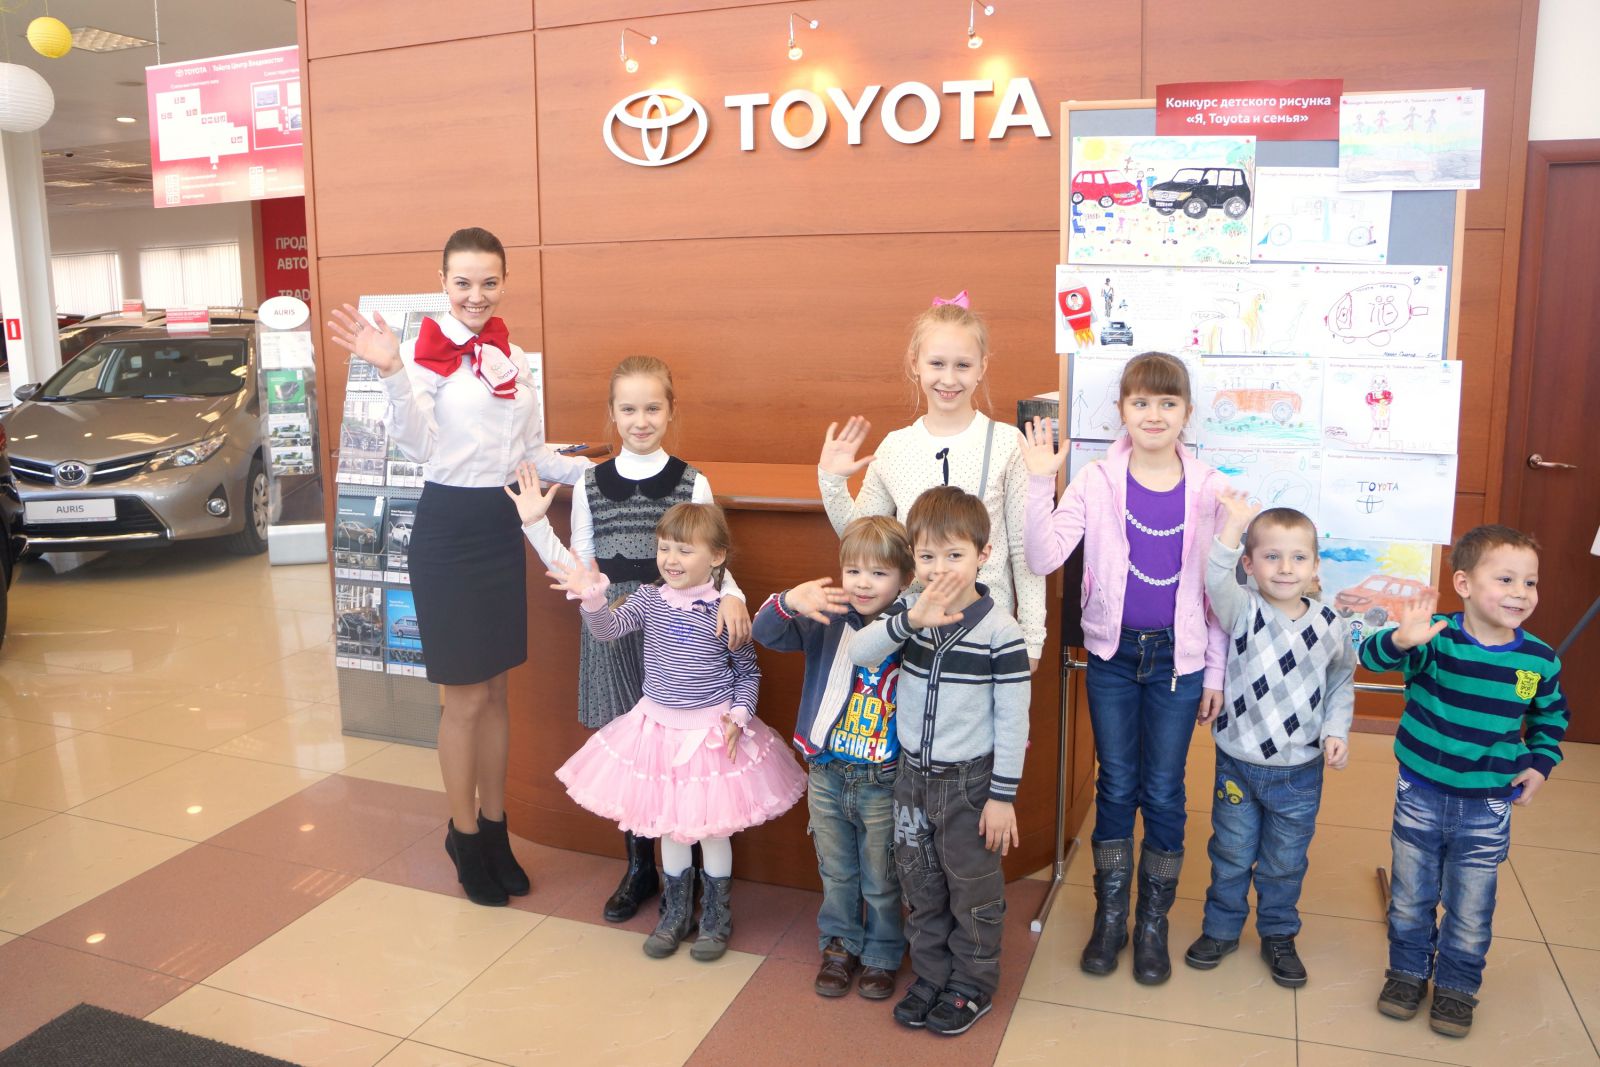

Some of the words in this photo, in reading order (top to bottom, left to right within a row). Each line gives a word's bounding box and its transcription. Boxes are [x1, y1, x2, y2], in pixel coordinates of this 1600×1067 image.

[1166, 97, 1217, 109] Конкурс
[1219, 97, 1277, 108] детского
[1279, 96, 1332, 109] рисунка
[725, 77, 1051, 151] TOYOTA
[1186, 114, 1206, 125] «Я,
[1209, 113, 1250, 126] Toyota
[1253, 115, 1261, 123] и
[1262, 114, 1309, 123] семья»
[1356, 481, 1399, 492] TOYOTA
[57, 505, 85, 513] AURIS
[836, 692, 896, 738] RST
